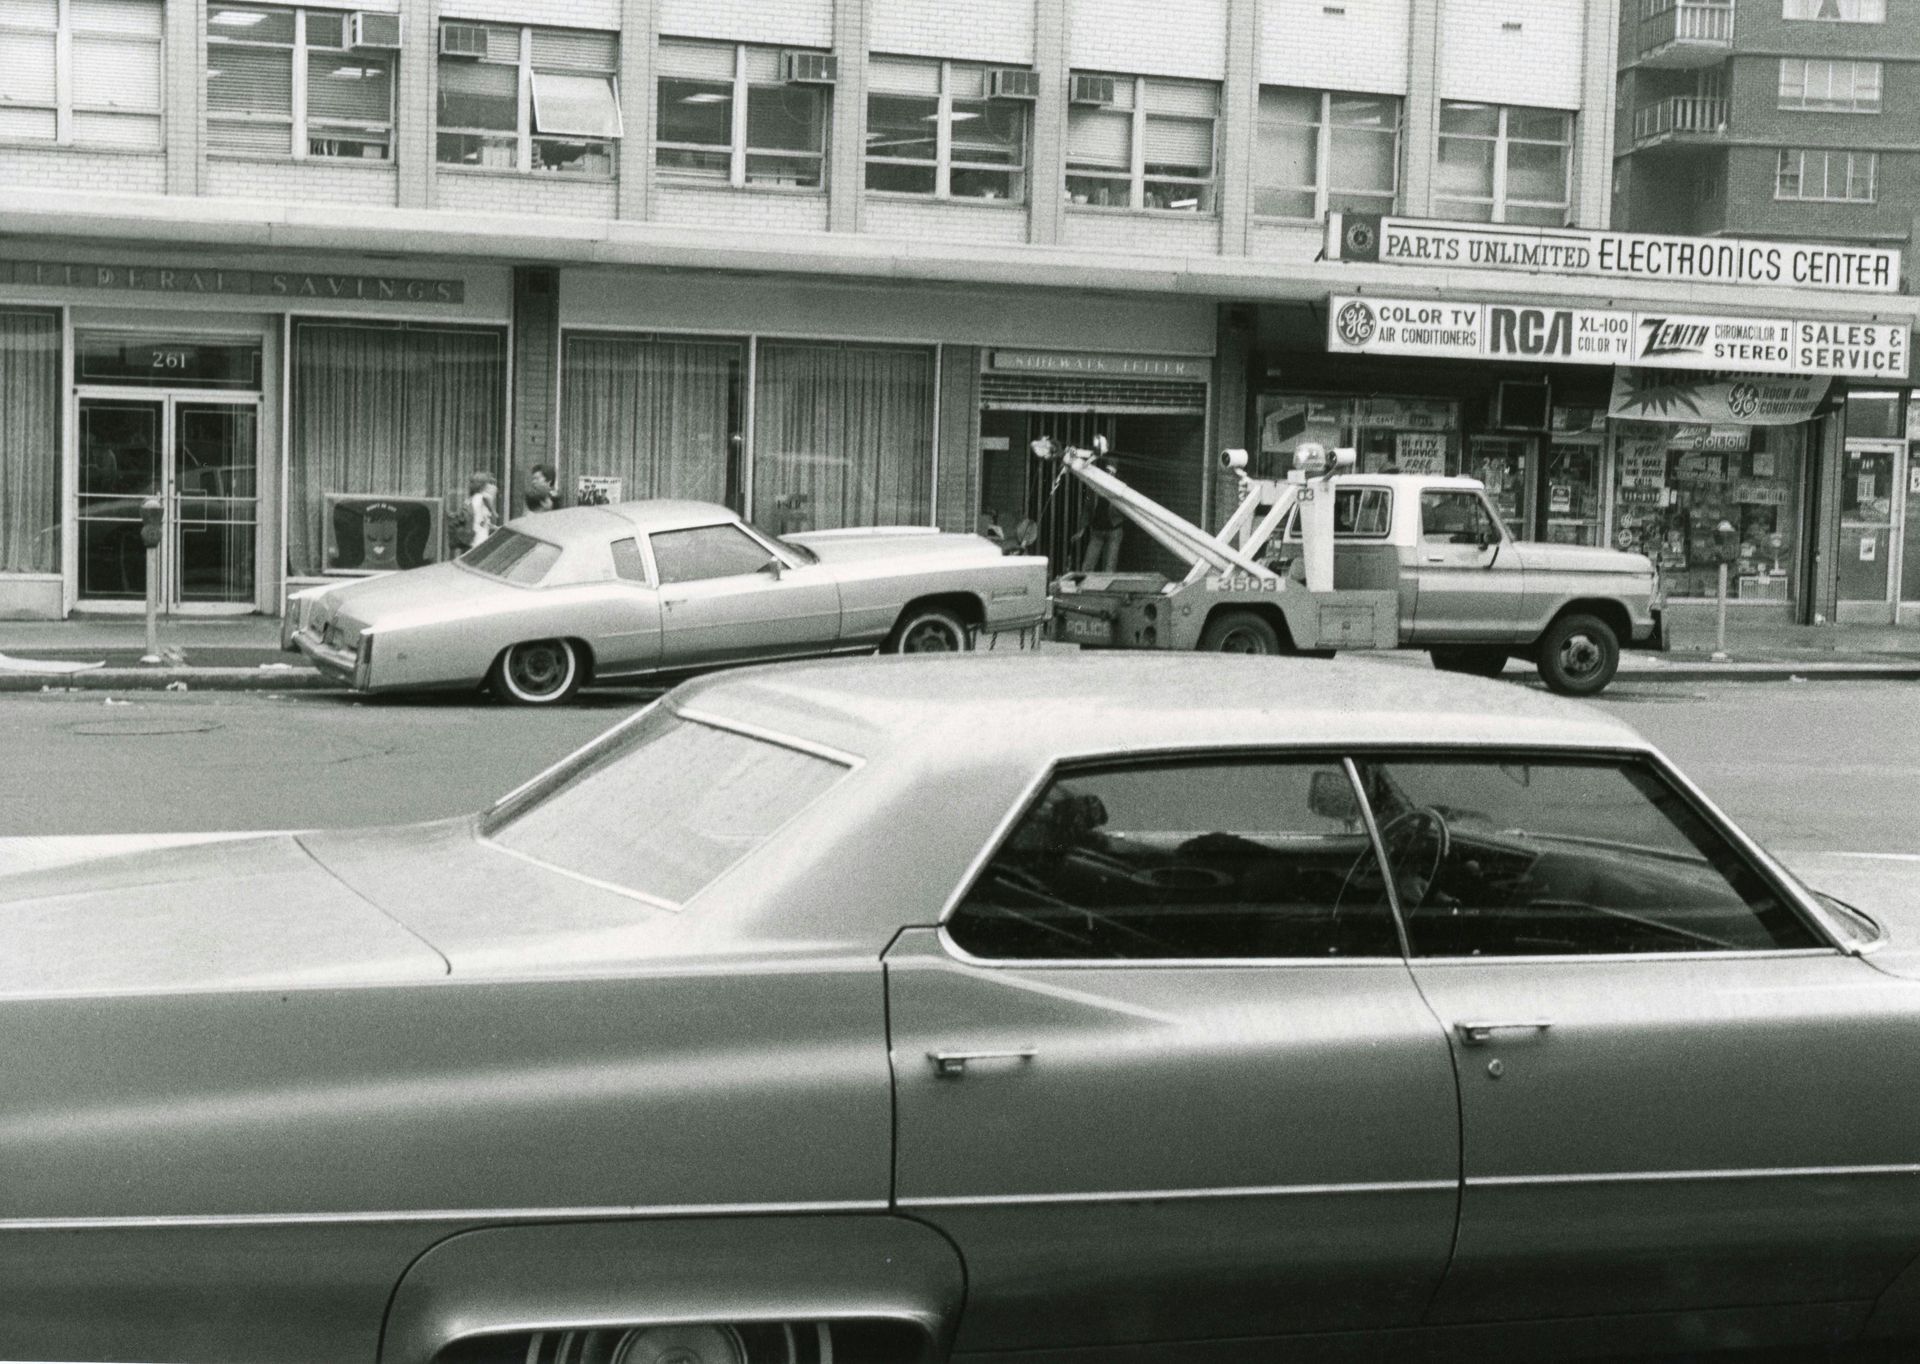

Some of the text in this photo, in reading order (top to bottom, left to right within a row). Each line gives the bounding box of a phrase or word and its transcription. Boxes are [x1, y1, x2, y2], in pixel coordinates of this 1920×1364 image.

[1386, 235, 1460, 260] PARTS
[1468, 240, 1590, 268] UNLIMITED
[1598, 238, 1782, 281] ELECTRONICS
[1793, 250, 1890, 286] CENTER
[273, 274, 451, 300] SAVINGS
[1379, 306, 1477, 326] COLOR TV
[1579, 316, 1629, 334] XL-100
[1378, 327, 1477, 347] AIR CONDITIONERS
[1490, 307, 1574, 357] RCA
[1639, 318, 1710, 357] ZENITH
[1801, 325, 1876, 346] SALES
[1578, 336, 1628, 354] COLOR TV
[1714, 343, 1789, 361] STEREO
[152, 351, 186, 369] 261
[1801, 348, 1902, 371] SERVICE
[1762, 386, 1792, 400] ROOM
[1218, 578, 1278, 593] 3503
[1066, 620, 1111, 637] POLICE
